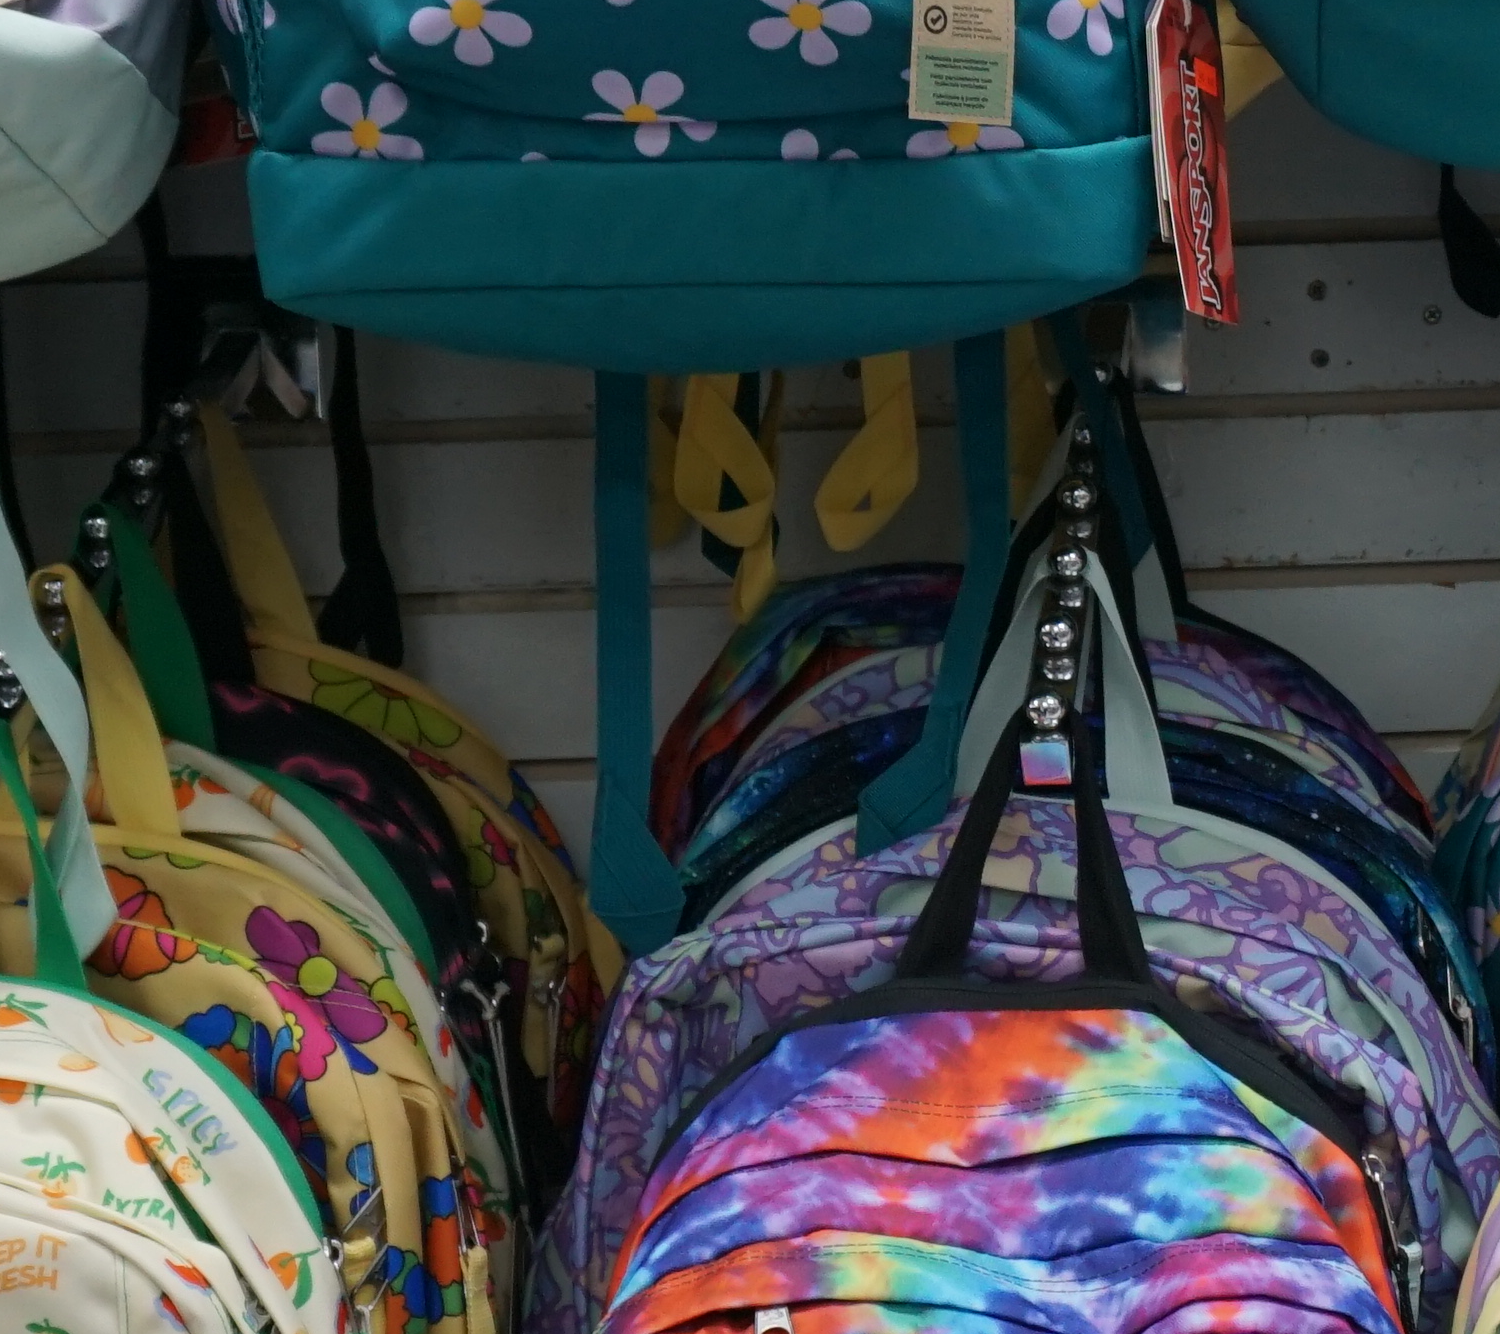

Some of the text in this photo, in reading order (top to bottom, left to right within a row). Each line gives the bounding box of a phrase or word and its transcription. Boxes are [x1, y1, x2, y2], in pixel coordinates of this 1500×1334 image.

[1179, 59, 1222, 311] JANSPORT
[141, 1068, 238, 1157] SPICY
[101, 1189, 178, 1229] EXTRA
[34, 1236, 68, 1261] IT
